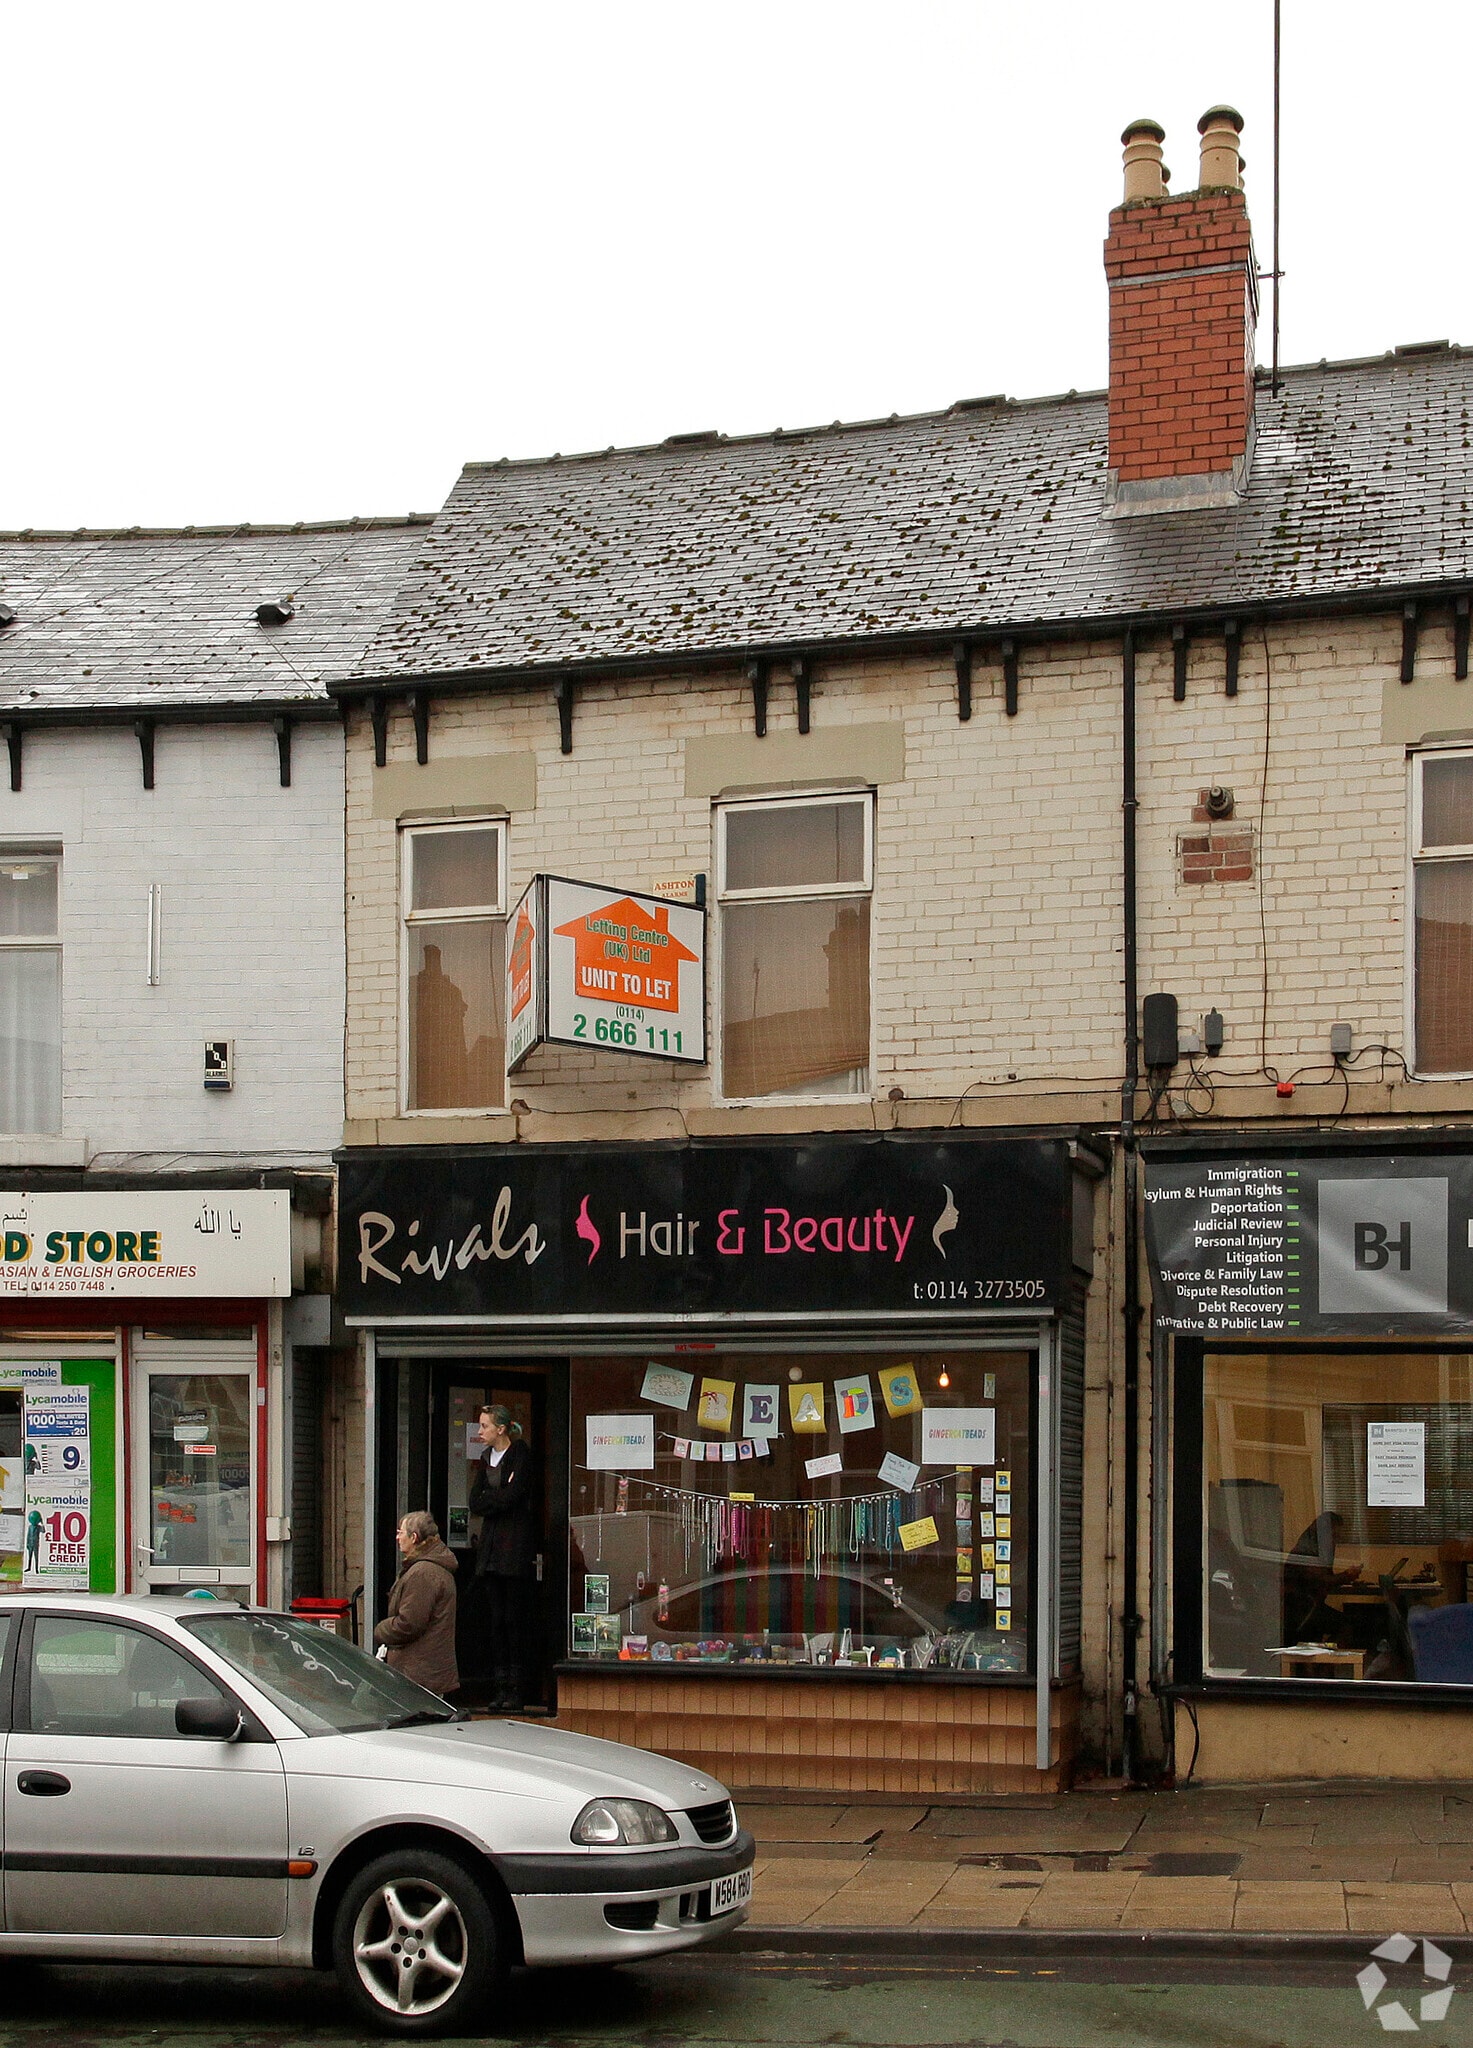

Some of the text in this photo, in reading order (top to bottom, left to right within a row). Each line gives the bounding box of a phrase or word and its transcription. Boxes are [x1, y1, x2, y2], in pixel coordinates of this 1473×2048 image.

[654, 880, 695, 891] ASHTON
[586, 917, 668, 946] Letting Centre
[604, 941, 651, 963] (UK) Ltd
[581, 966, 672, 1000] UNIT TO LET
[615, 1006, 645, 1023] (0114)
[573, 1014, 683, 1053] 2 666 111
[1207, 1168, 1282, 1182] Immigration
[1185, 1187, 1195, 1199] &
[1198, 1185, 1241, 1198] Human
[1244, 1184, 1283, 1198] Rights
[1211, 1201, 1283, 1216] Deportation
[1193, 1218, 1283, 1232] Judicial Review
[358, 1186, 915, 1284] Rivals Hair & Beauty
[1194, 1235, 1283, 1248] Personal Injury
[45, 1231, 162, 1264] STORE
[1354, 1221, 1411, 1271] BH
[1226, 1251, 1283, 1267] Litigation
[0, 1265, 197, 1278] ASIAN & ENGLISH GROCERIES
[1160, 1268, 1283, 1284] Divorce & Family Law
[31, 1281, 55, 1291] 0114
[58, 1281, 77, 1291] 250
[80, 1281, 105, 1291] 7448
[974, 1280, 1046, 1299] 3273505
[1176, 1284, 1283, 1300] Dispute Resolution
[1198, 1301, 1284, 1315] Debt Recovery
[1207, 1317, 1219, 1329] &
[1221, 1317, 1257, 1329] Public
[1260, 1318, 1284, 1329] Law
[0, 1368, 57, 1378] ycamobile
[26, 1394, 87, 1405] Lycamobile
[27, 1414, 56, 1426] 1000
[27, 1494, 88, 1505] Lycamobile
[45, 1511, 87, 1543] £10
[49, 1543, 86, 1555] FREE
[49, 1554, 86, 1563] CREDIT
